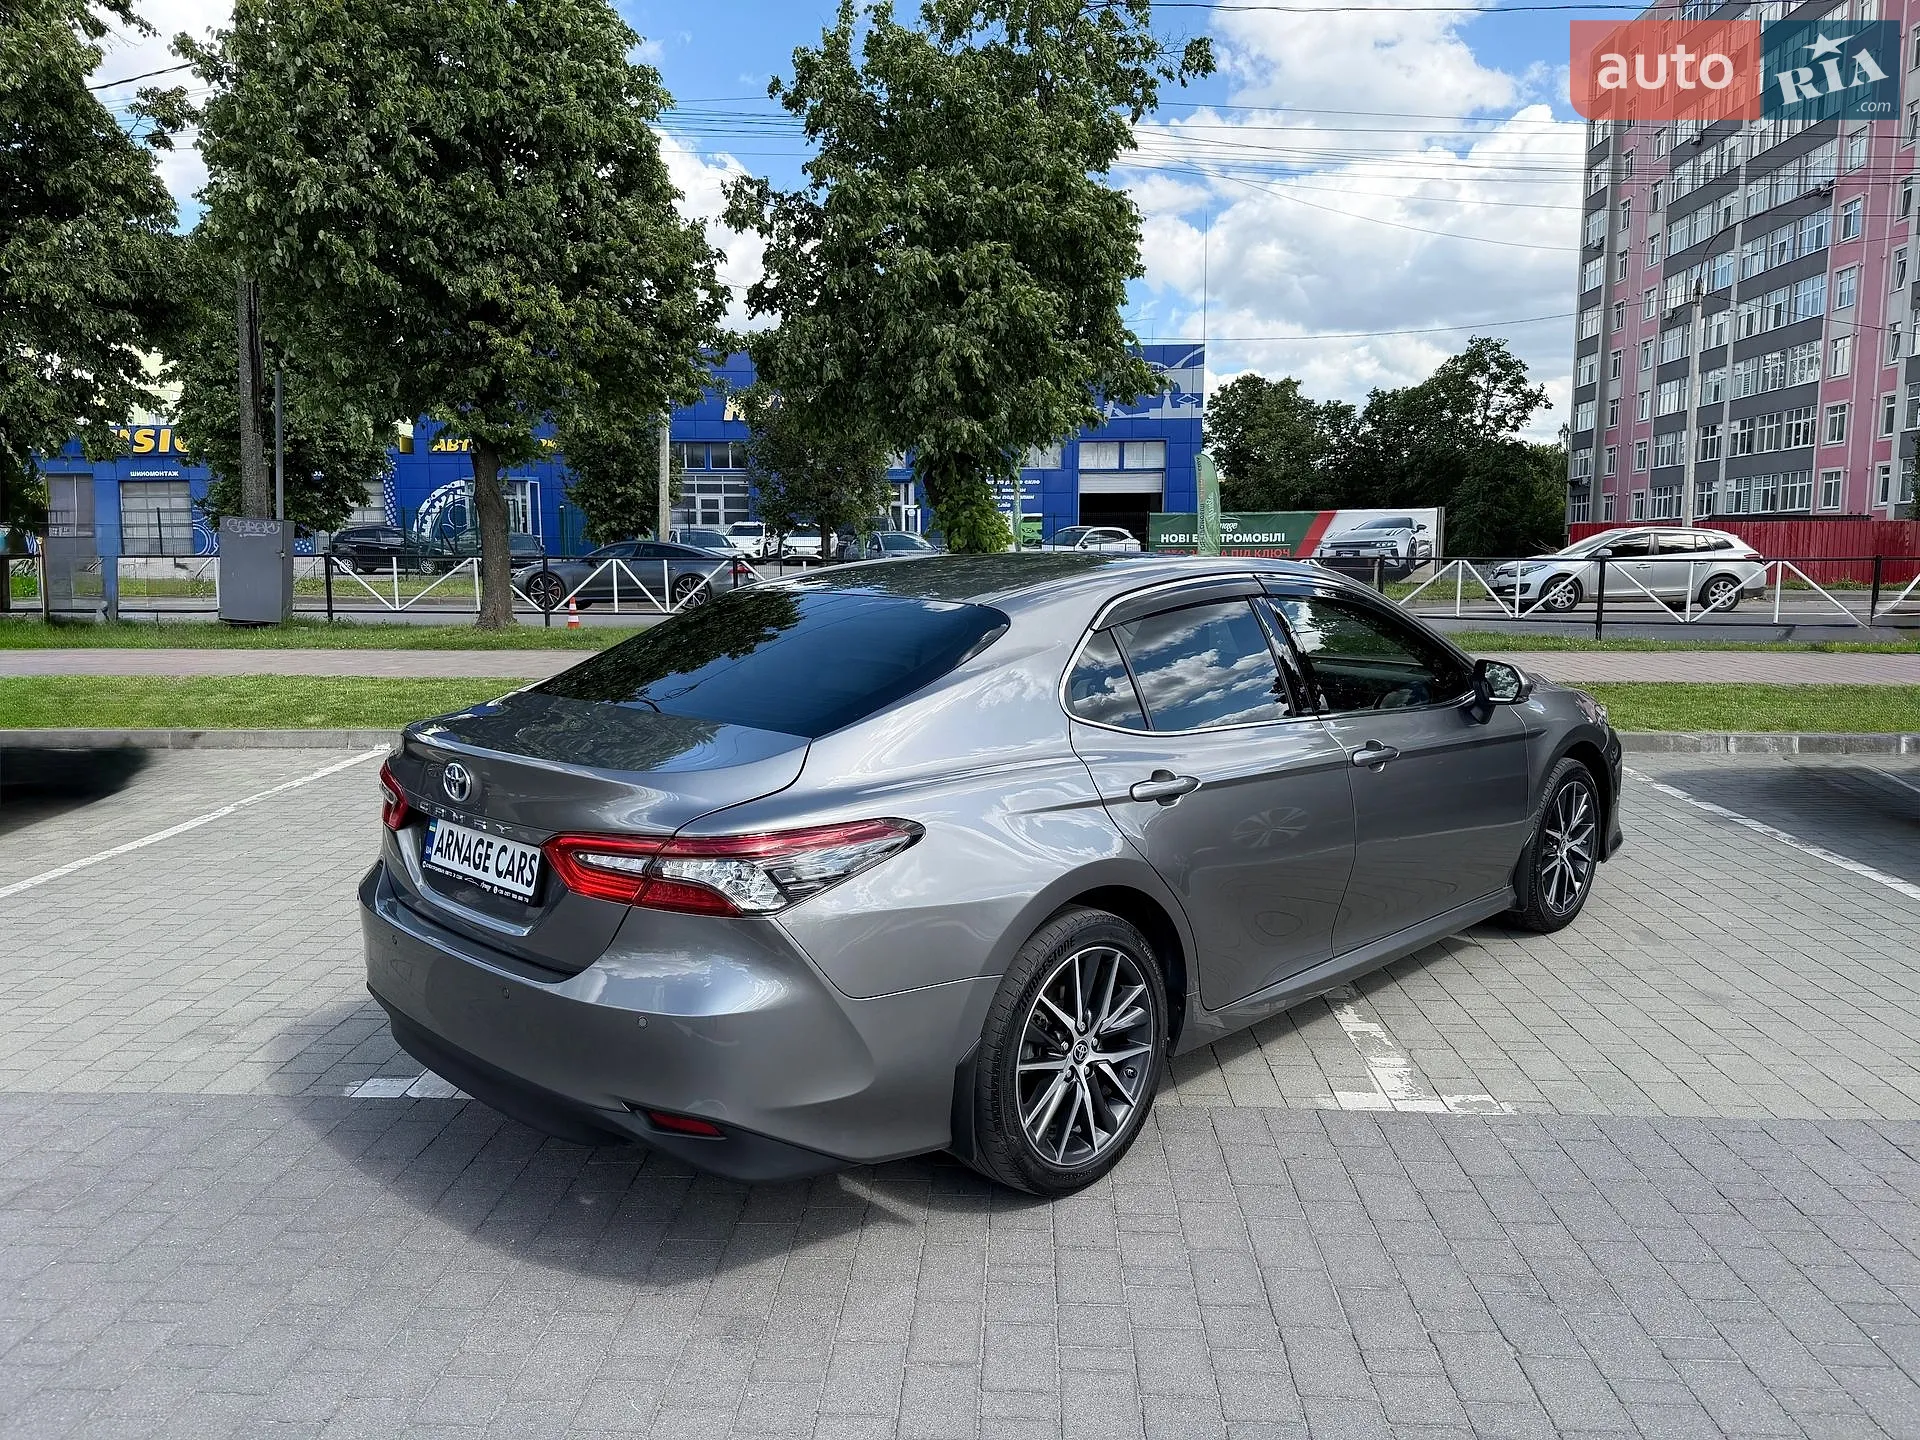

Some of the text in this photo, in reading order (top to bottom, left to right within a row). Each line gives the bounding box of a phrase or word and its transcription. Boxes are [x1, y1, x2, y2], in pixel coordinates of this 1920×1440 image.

[1160, 533, 1286, 543] НОВІ ЕТРОМОБІЛІ
[419, 801, 512, 834] CAMRY
[434, 827, 494, 873] ARNAGE
[495, 845, 537, 888] CARS
[1017, 936, 1076, 1012] BRIDGESTONE
